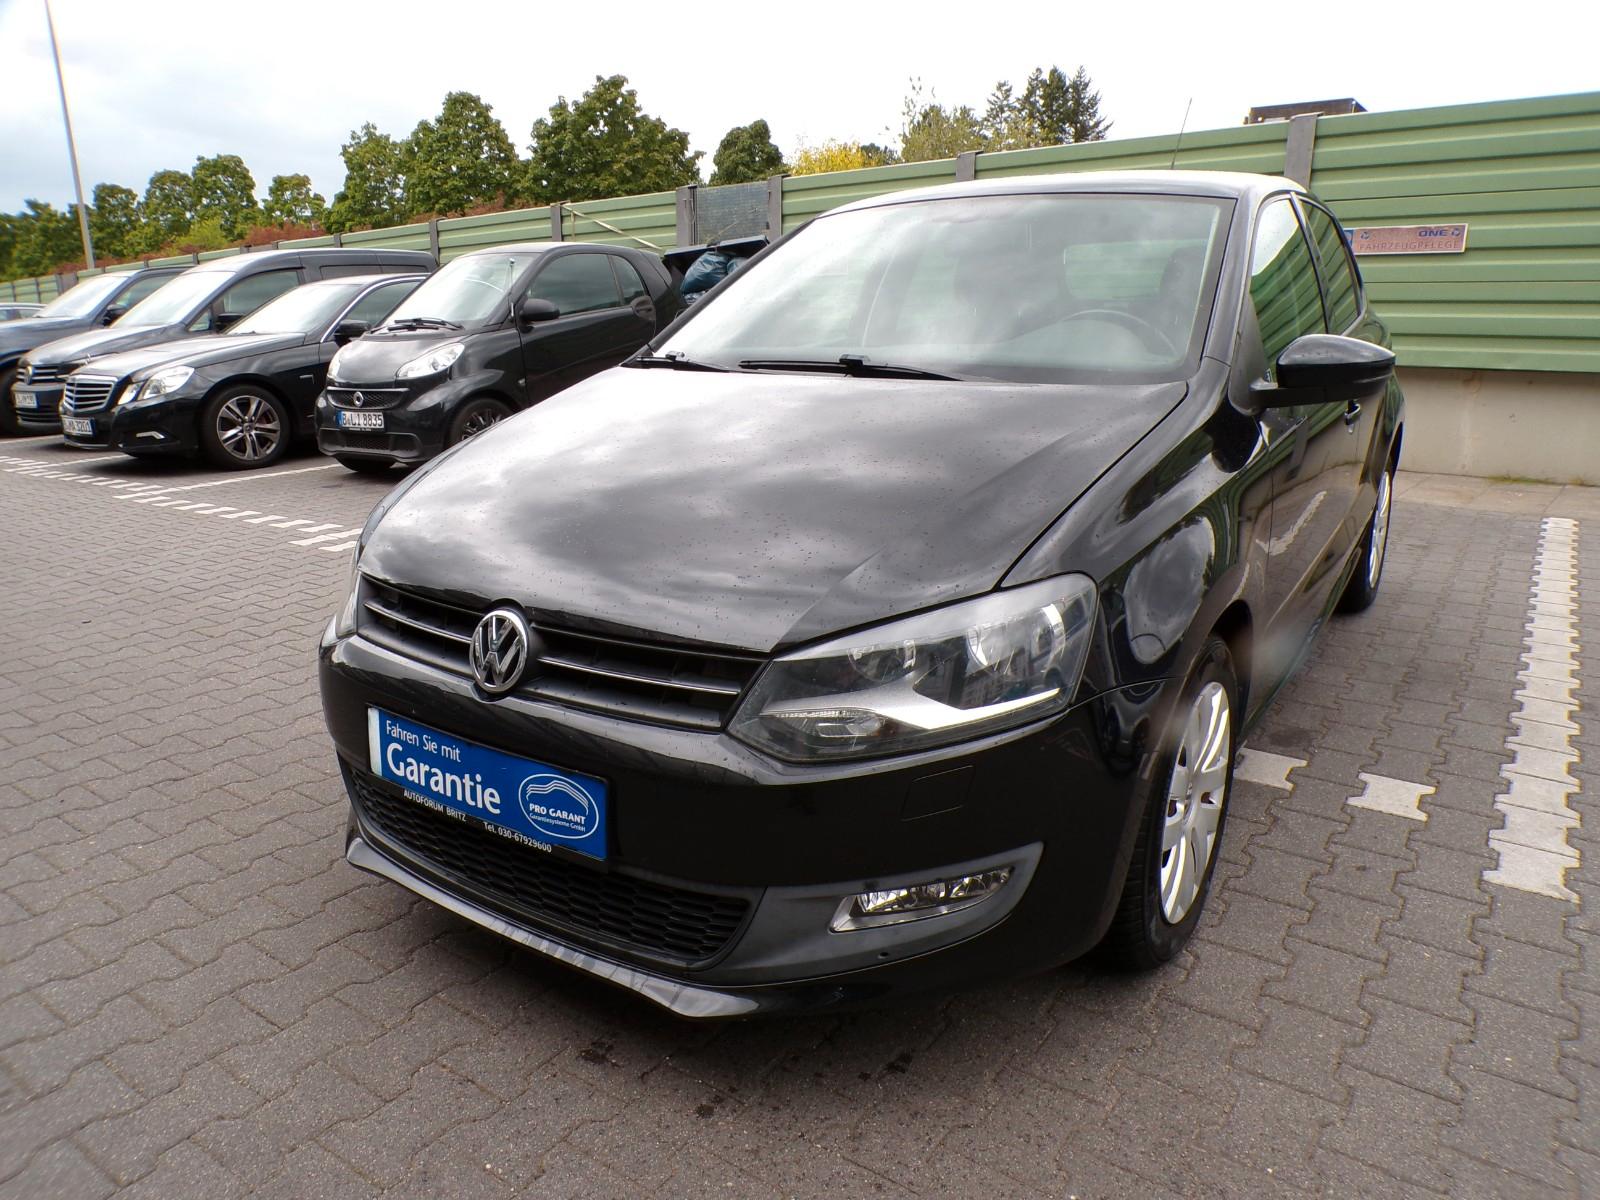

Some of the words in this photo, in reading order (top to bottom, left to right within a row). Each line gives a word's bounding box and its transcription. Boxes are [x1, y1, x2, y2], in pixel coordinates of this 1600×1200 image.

[1418, 229, 1448, 238] ONE
[1359, 240, 1460, 250] FAHRZEUGPFLEGE
[362, 413, 383, 427] 8835
[386, 720, 420, 747] Fahren
[423, 734, 438, 754] Sie
[441, 745, 462, 762] mit
[386, 742, 501, 815] Garantie
[403, 789, 444, 813] AUTOFORUM
[446, 807, 467, 822] BRITZ
[483, 821, 497, 834] Tel.
[497, 826, 552, 853] 030-67929600
[529, 803, 547, 815] PRO
[548, 808, 587, 825] GARANT
[529, 813, 570, 828] Garantiesysteme
[570, 822, 586, 833] GmbH
